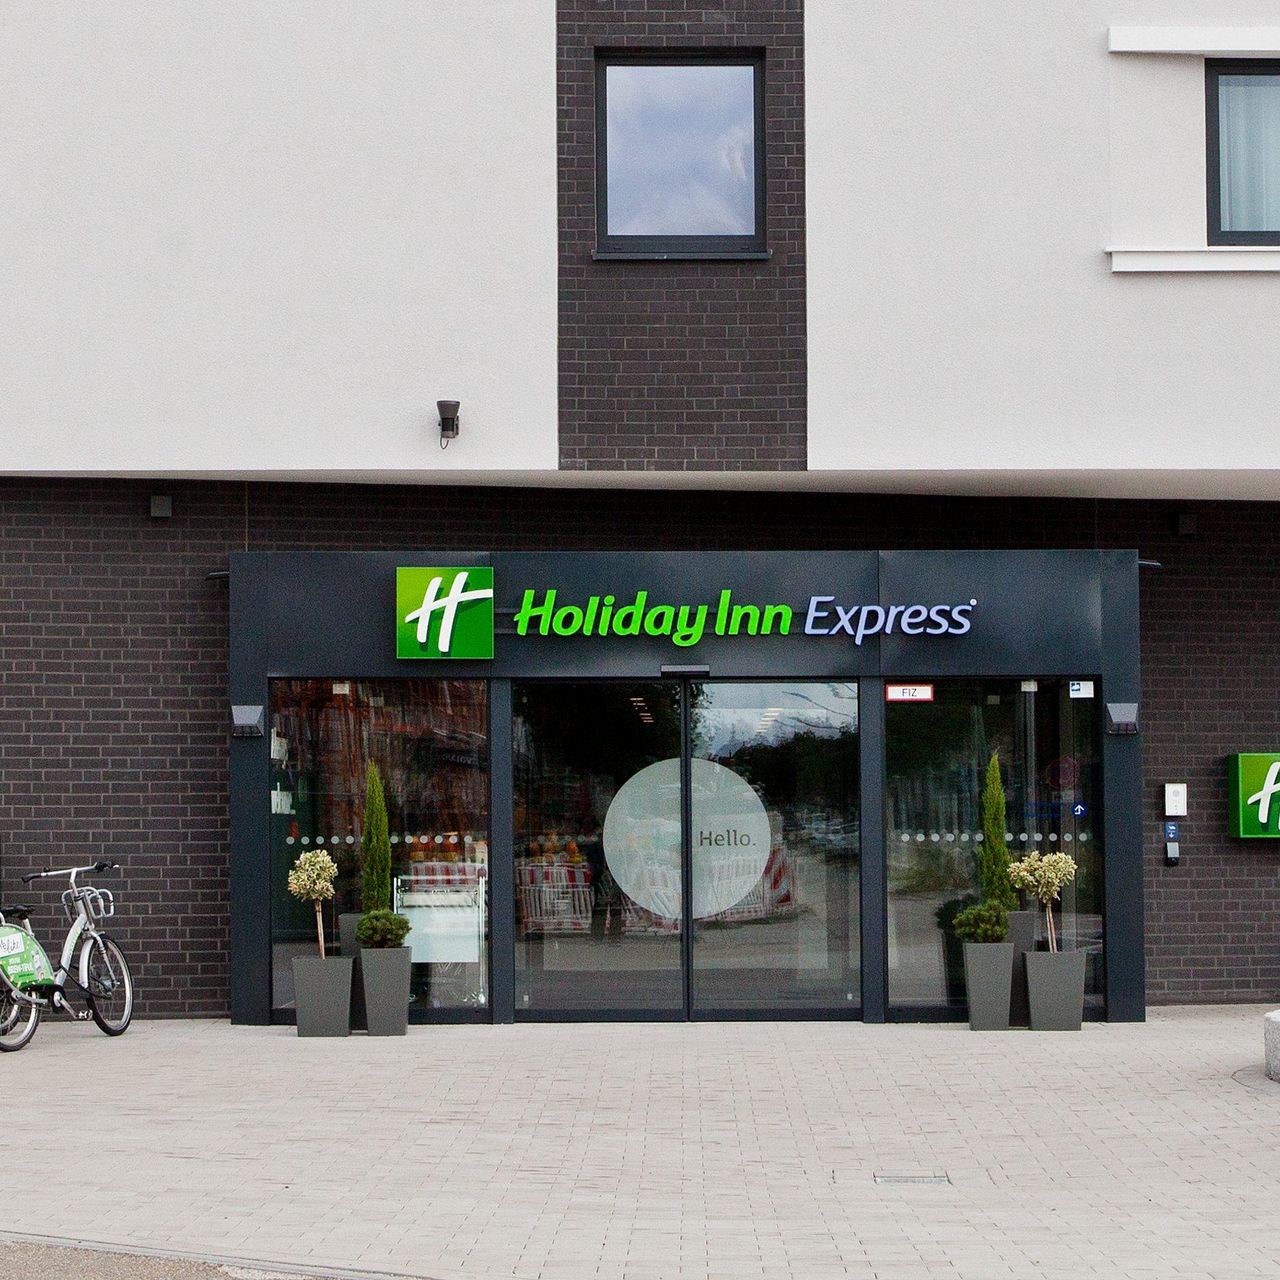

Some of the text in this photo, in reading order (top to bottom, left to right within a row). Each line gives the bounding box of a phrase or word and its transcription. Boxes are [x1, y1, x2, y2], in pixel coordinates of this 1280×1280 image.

[513, 589, 707, 646] Holiday
[716, 589, 791, 636] Inn
[902, 688, 917, 697] FIZ
[700, 829, 756, 846] Hello.
